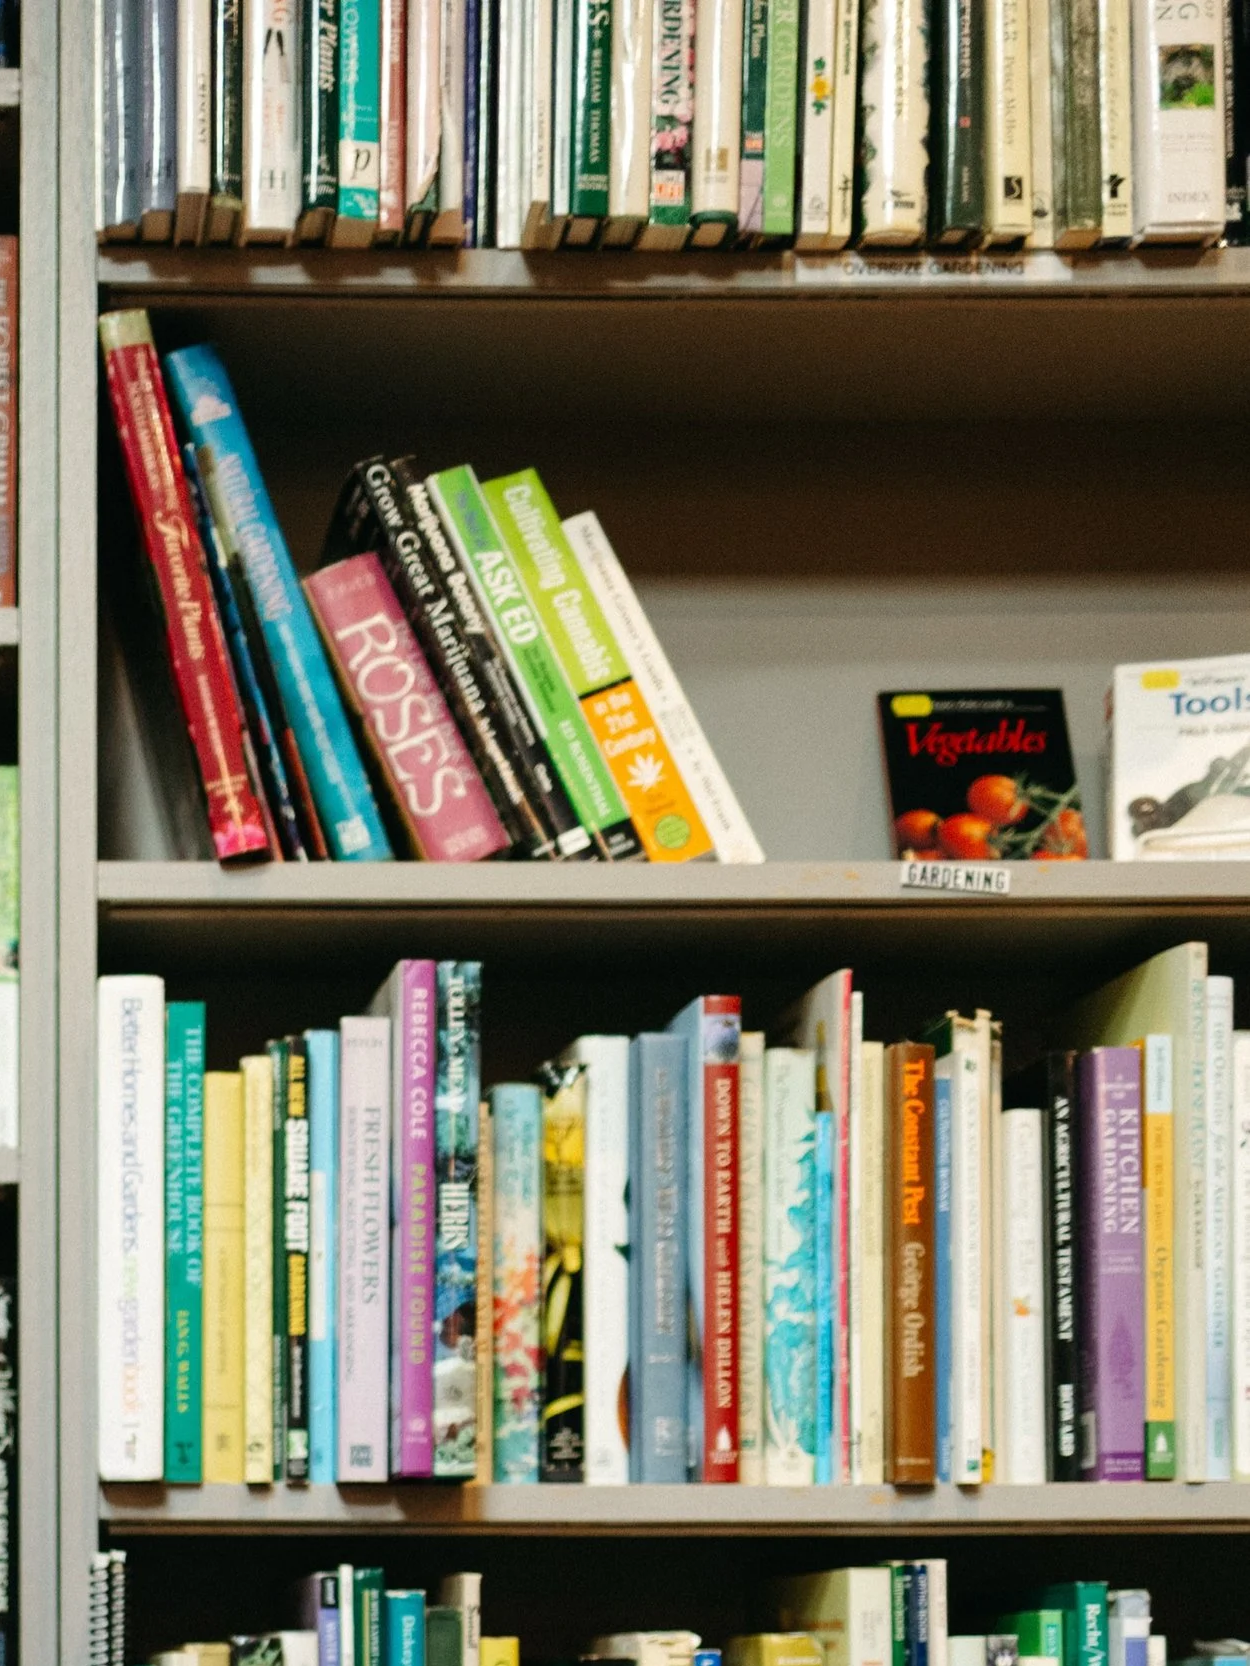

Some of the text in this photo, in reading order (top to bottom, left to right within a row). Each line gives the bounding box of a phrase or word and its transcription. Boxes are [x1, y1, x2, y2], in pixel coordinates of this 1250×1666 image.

[366, 463, 485, 715] Grow Great Marijuana
[474, 549, 539, 645] ASK ED
[502, 483, 568, 590] Cultivating
[334, 612, 467, 817] ROSES
[905, 717, 1047, 767] Vegetables
[907, 863, 1006, 891] GARDENING
[362, 1107, 382, 1304] FRESH FLOWERS
[409, 987, 427, 1365] REBECCA COLE PARADISE FOUND
[897, 1059, 925, 1378] The Constant Pest George Ordish
[1102, 1109, 1118, 1233] GARDENING
[1119, 1108, 1139, 1233] KITCHEN
